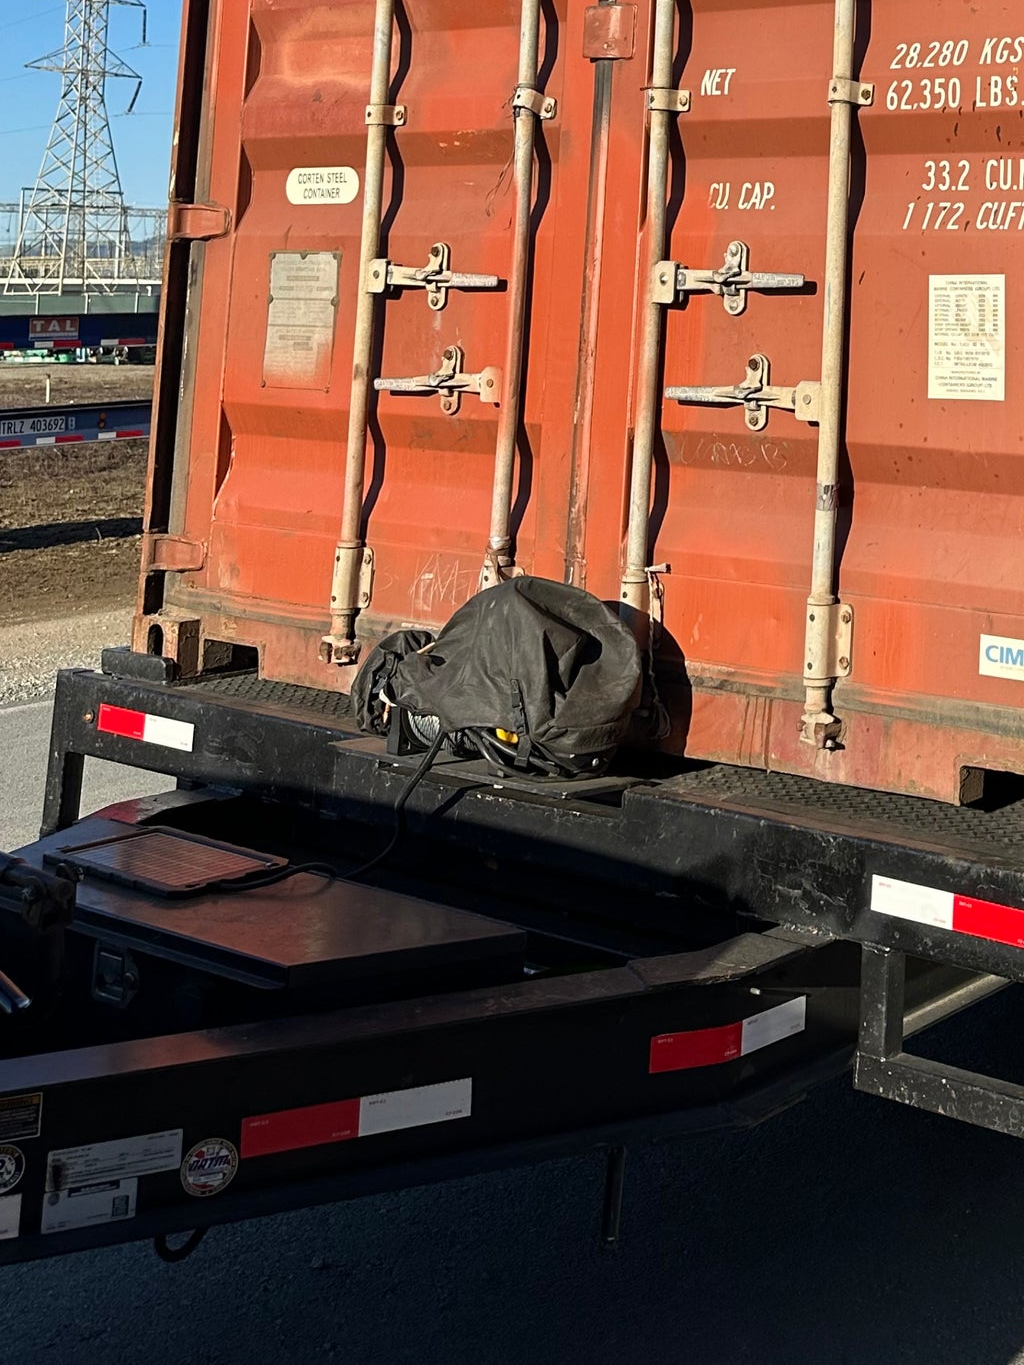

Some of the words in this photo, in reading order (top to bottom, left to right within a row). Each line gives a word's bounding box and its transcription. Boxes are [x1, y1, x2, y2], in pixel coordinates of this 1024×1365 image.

[889, 39, 969, 70] 28,280
[700, 67, 736, 97] NET
[886, 77, 961, 111] 62,350
[298, 172, 325, 185] CORTEN
[326, 171, 348, 184] STEEL
[921, 159, 970, 192] 33.2
[303, 187, 341, 200] CONTAINER
[738, 181, 776, 210] CAP.
[32, 320, 77, 332] TAL
[1, 421, 25, 435] TRLZ
[29, 417, 65, 432] 403692
